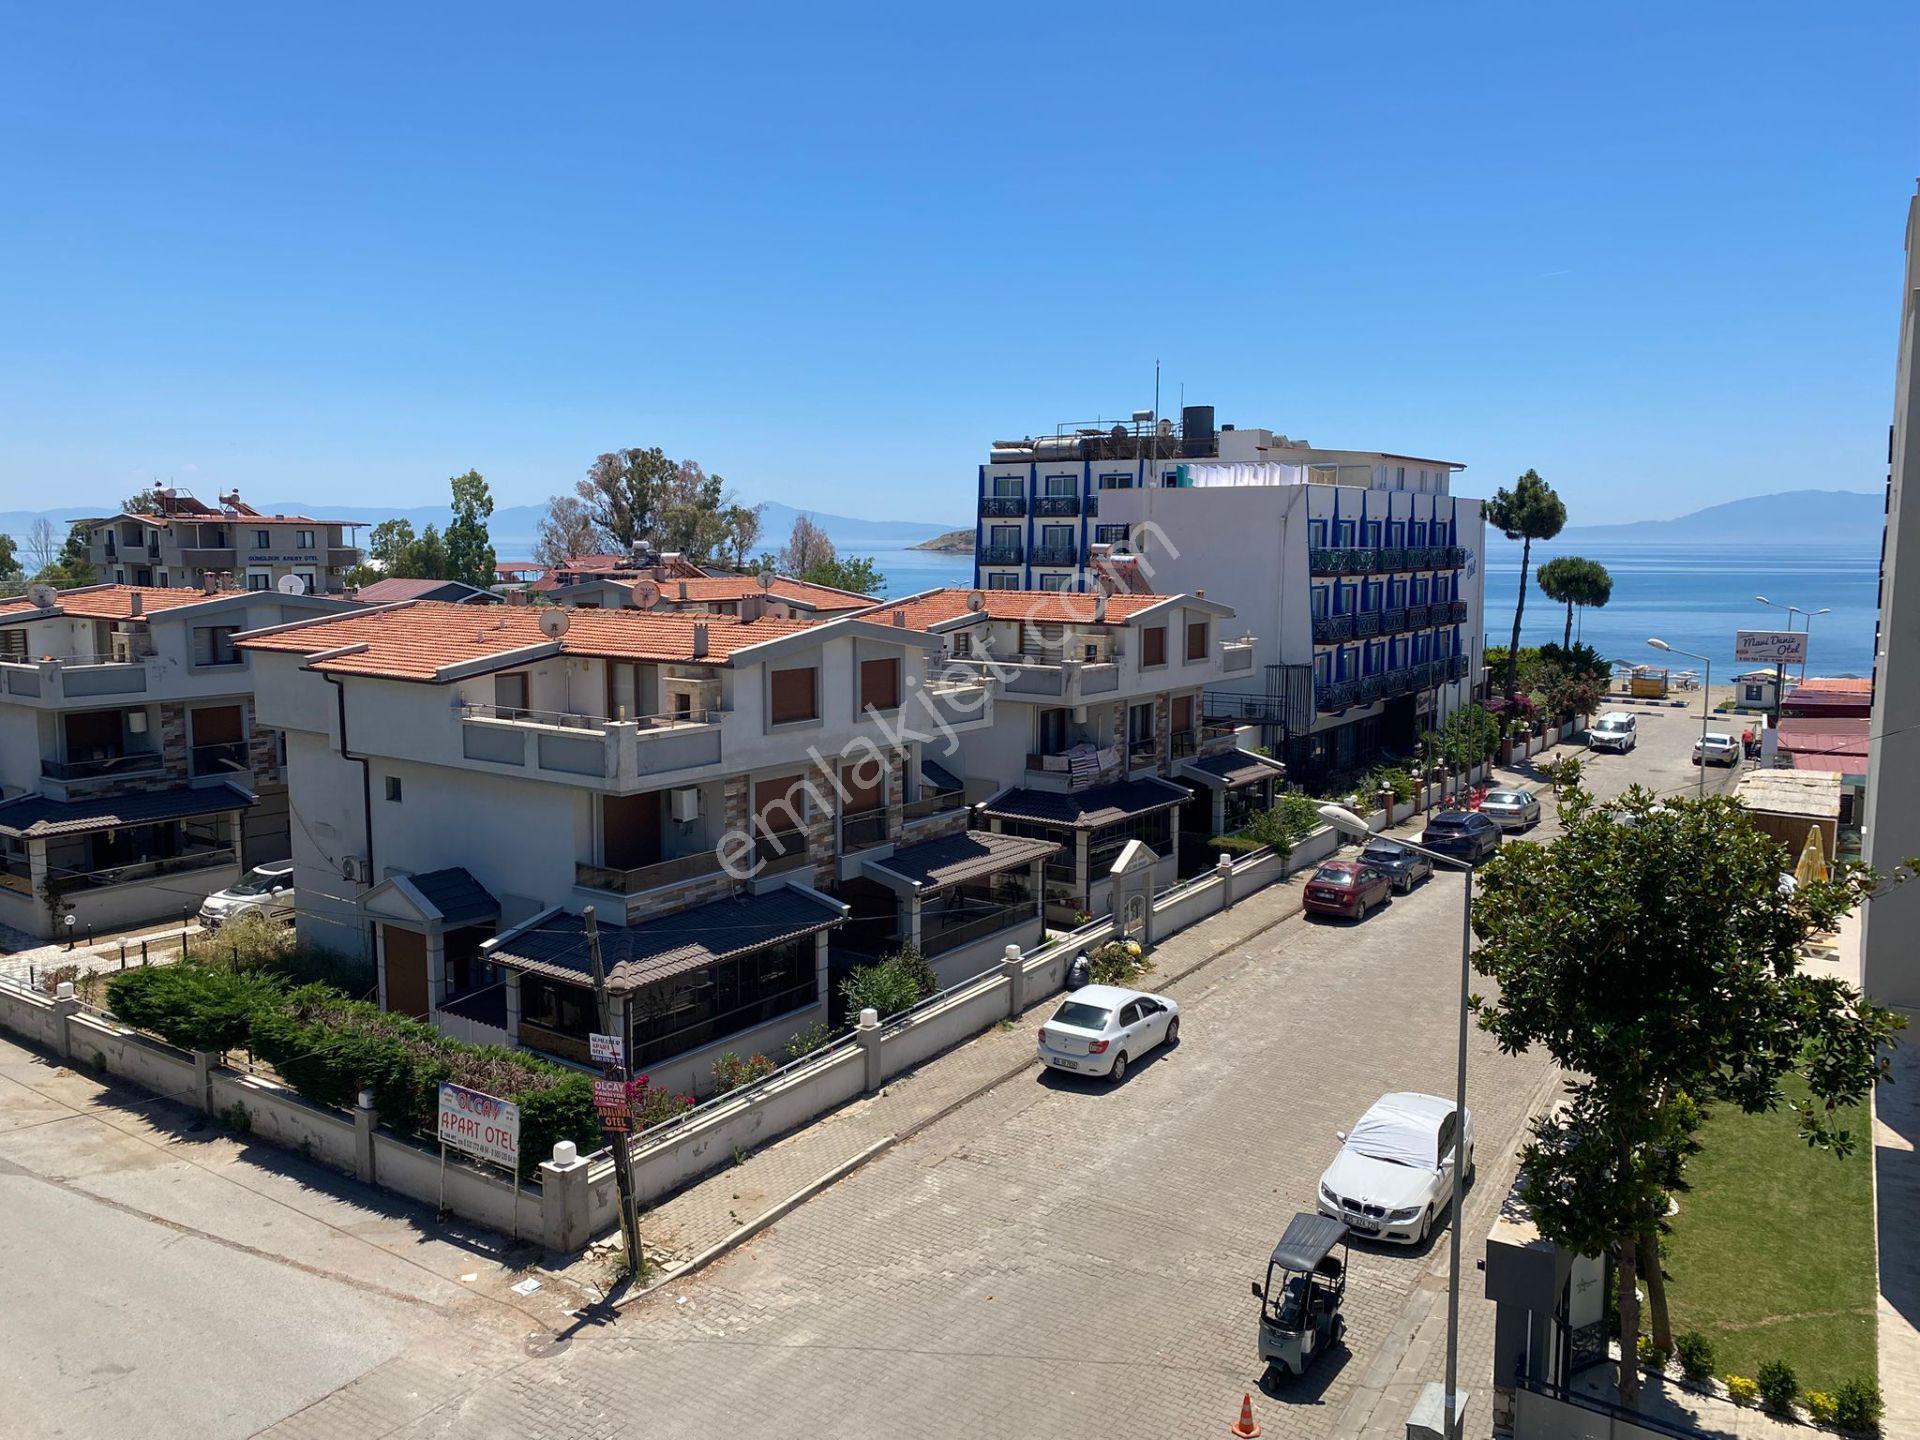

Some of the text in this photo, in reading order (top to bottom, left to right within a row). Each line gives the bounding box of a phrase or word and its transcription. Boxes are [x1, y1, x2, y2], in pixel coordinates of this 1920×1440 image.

[1743, 635, 1796, 647] Mavi Deniz
[1777, 642, 1800, 655] Otel
[595, 1081, 625, 1092] OLCAY
[457, 1092, 500, 1120] OLCAY
[605, 1117, 626, 1127] OTEL
[441, 1112, 480, 1139] APART
[485, 1126, 516, 1152] OTEL
